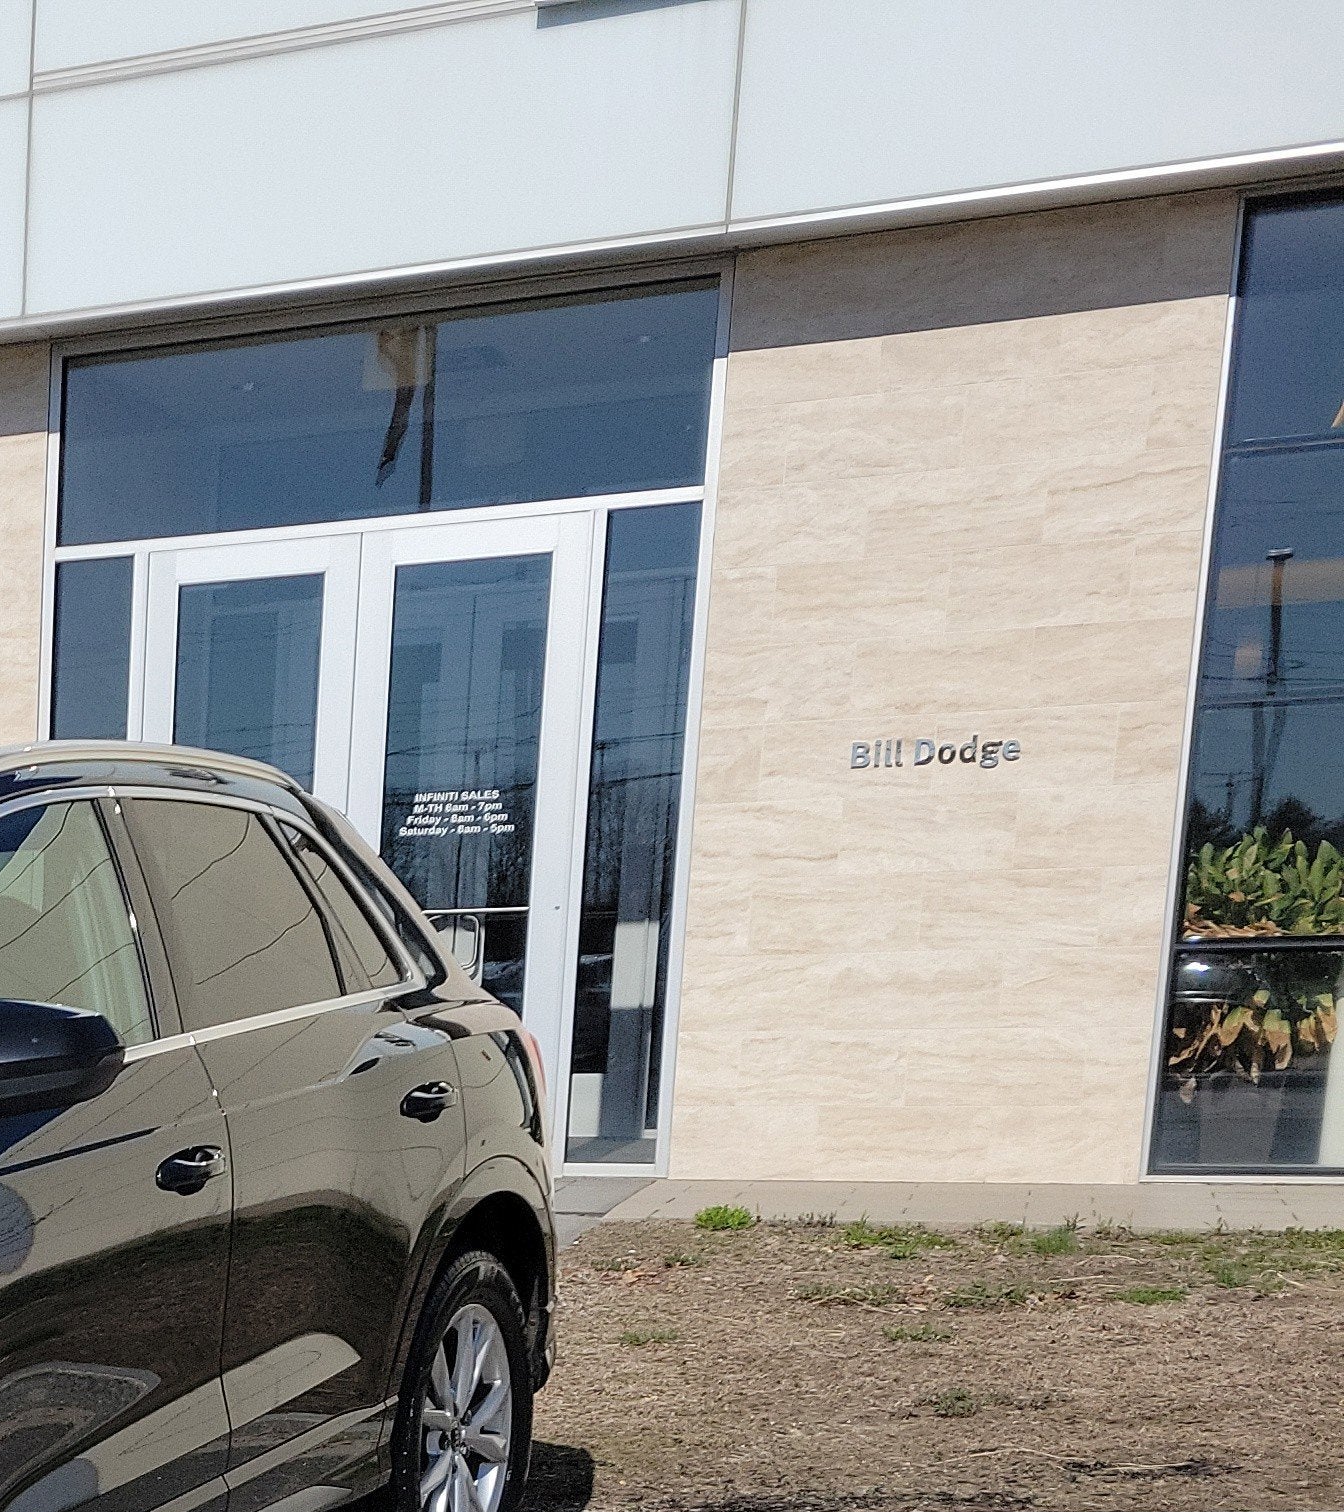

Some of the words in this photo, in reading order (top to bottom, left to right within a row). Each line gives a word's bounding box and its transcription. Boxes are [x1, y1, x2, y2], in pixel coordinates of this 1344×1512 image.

[850, 737, 904, 769] Bill
[913, 734, 1021, 769] Dodge
[414, 791, 459, 802] INFINITI
[460, 789, 500, 800] SALES
[413, 803, 443, 814] M-TH
[477, 801, 503, 813] 7pm
[406, 814, 442, 826] Friday
[398, 825, 448, 837] Saturday
[490, 823, 516, 834] 5pm
